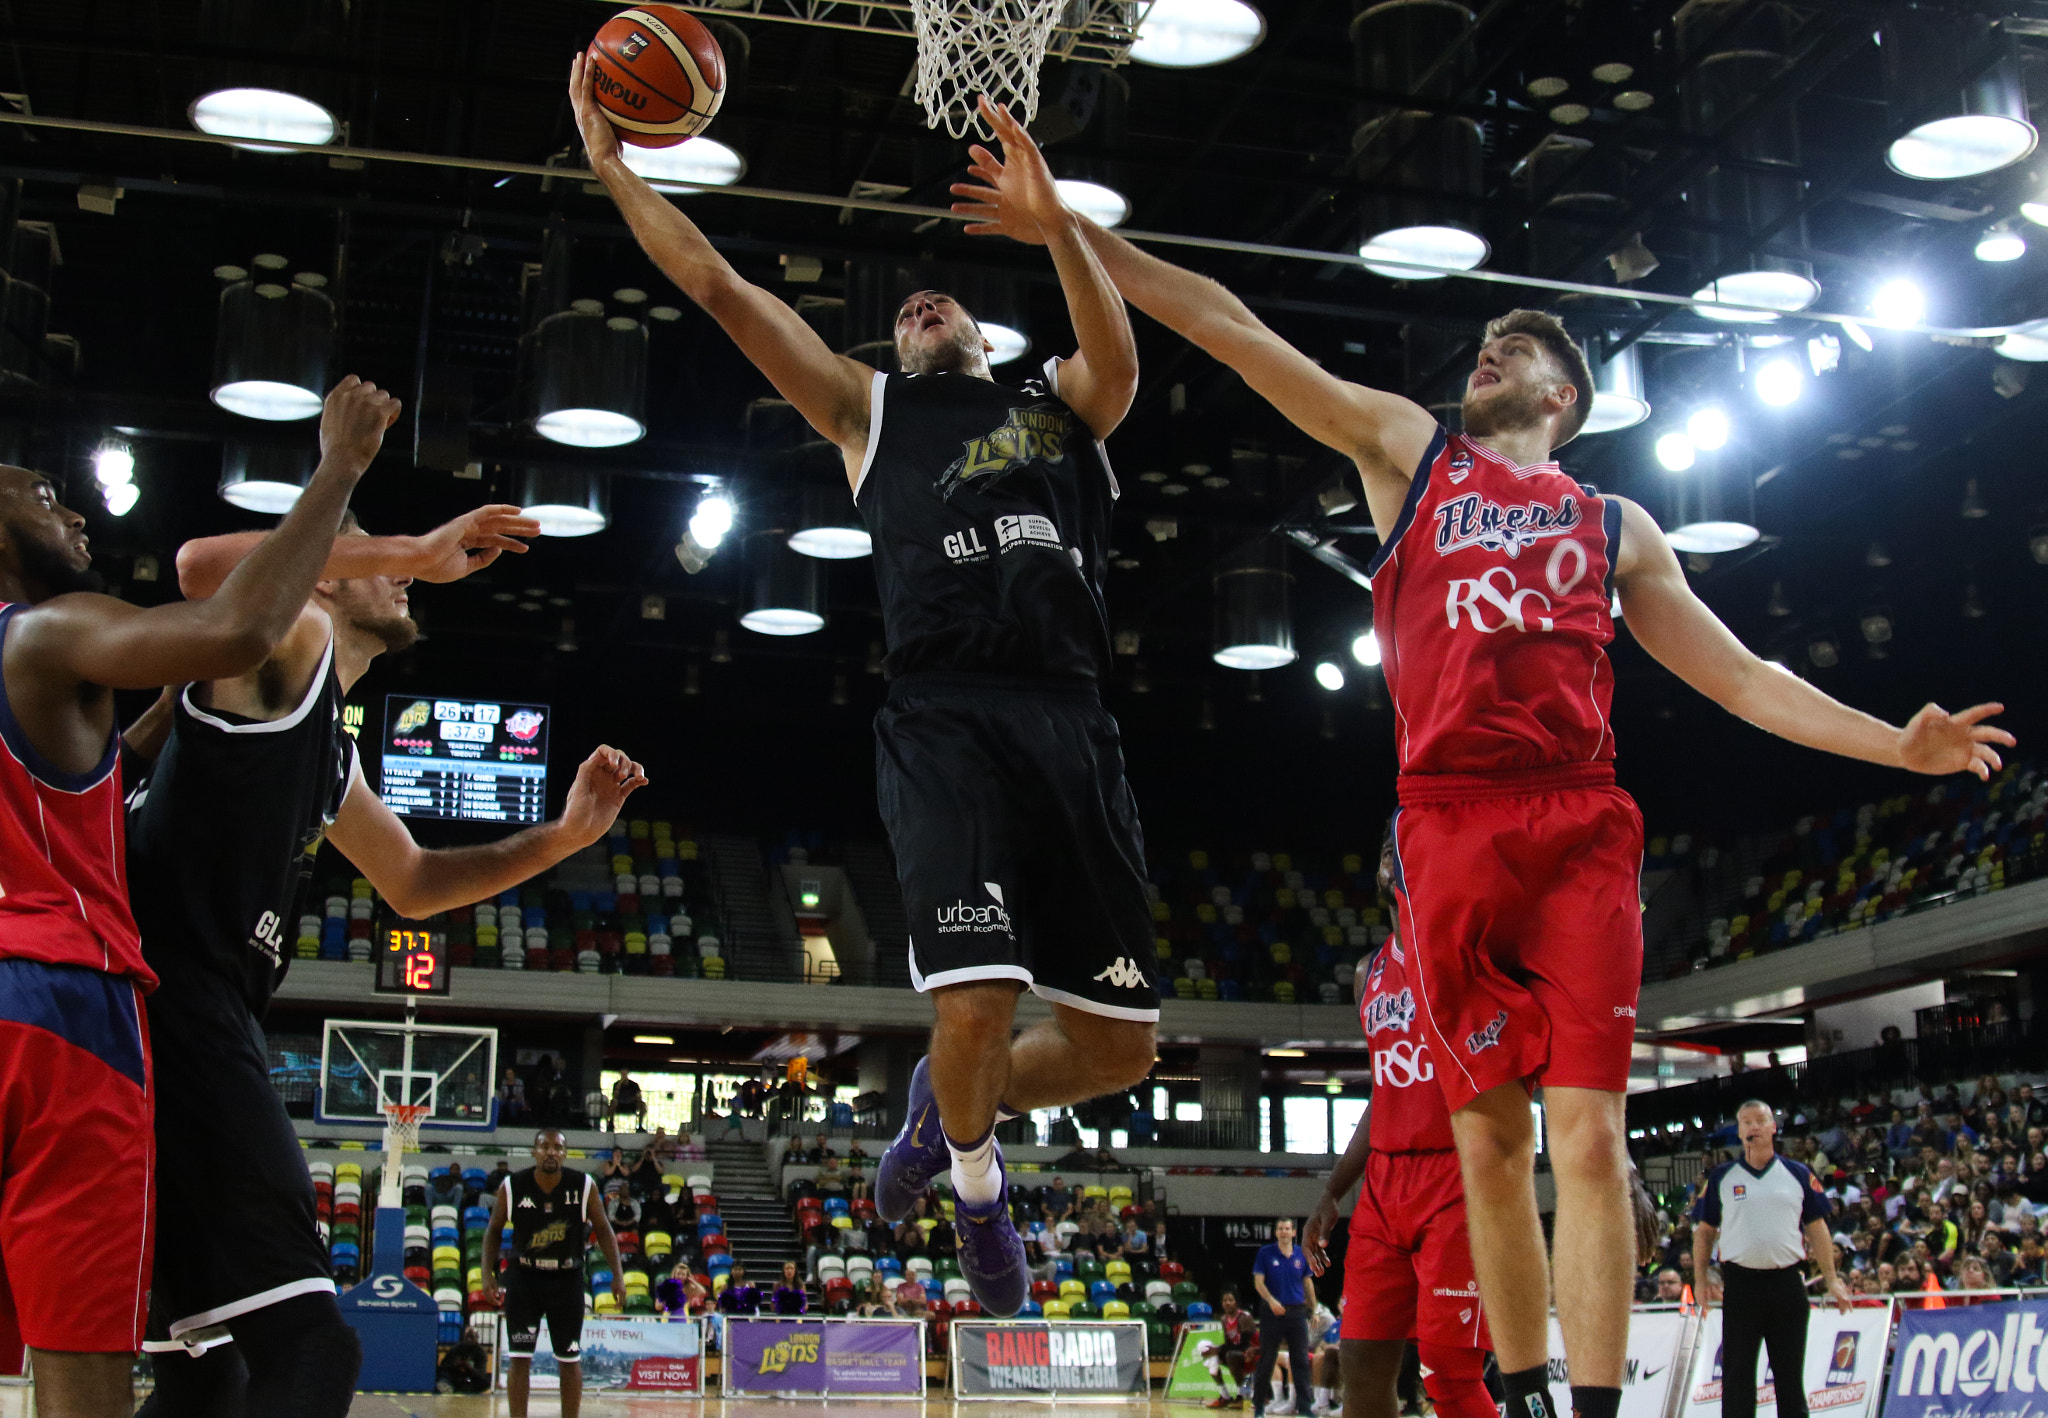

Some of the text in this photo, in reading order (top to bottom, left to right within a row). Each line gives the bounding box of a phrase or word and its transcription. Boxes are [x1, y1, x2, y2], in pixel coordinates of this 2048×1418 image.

[593, 66, 648, 110] molte
[1436, 492, 1582, 552] Flyers
[943, 527, 987, 559] GLL
[1027, 540, 1064, 551] FOUNDATION
[1546, 539, 1587, 596] 0
[1446, 566, 1554, 634] RSG
[438, 705, 456, 718] 26
[479, 708, 495, 722] 17
[393, 769, 423, 778] TAYLOR
[938, 919, 971, 933] student
[390, 930, 430, 951] 37.7
[405, 953, 436, 989] 12
[1374, 1032, 1434, 1088] RSG
[565, 1190, 579, 1205] 11
[586, 1329, 643, 1340] THE VIEW!
[883, 1359, 906, 1367] TEAM
[638, 1371, 690, 1380] VISIT NOW
[988, 1366, 1118, 1388] WEAREBANG.COM
